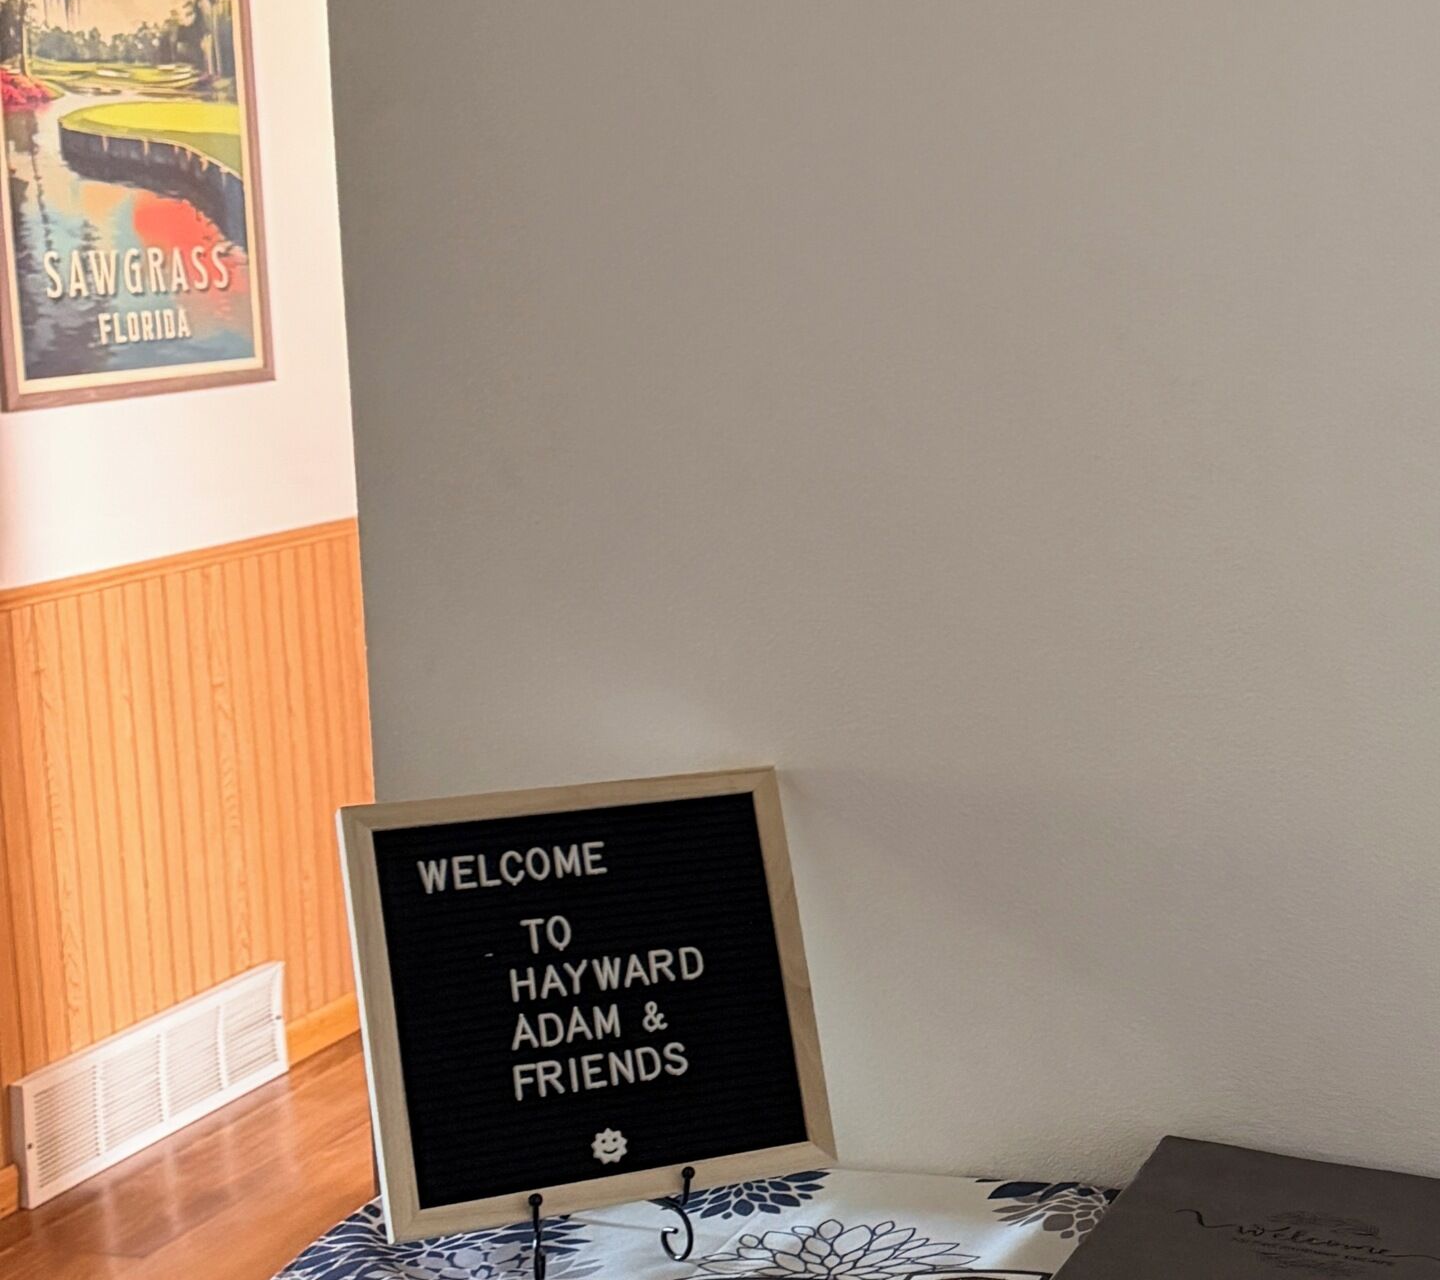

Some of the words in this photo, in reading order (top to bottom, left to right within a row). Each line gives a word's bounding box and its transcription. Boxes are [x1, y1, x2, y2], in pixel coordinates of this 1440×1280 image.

[43, 245, 231, 299] SAWGRASS
[98, 307, 192, 345] FLORIDA
[417, 841, 608, 894] WELCOME
[520, 915, 572, 953] TO
[510, 946, 704, 1002] HAYWARD
[511, 1004, 621, 1050] ADAM
[642, 1001, 668, 1033] &
[512, 1042, 689, 1101] FRIENDS
